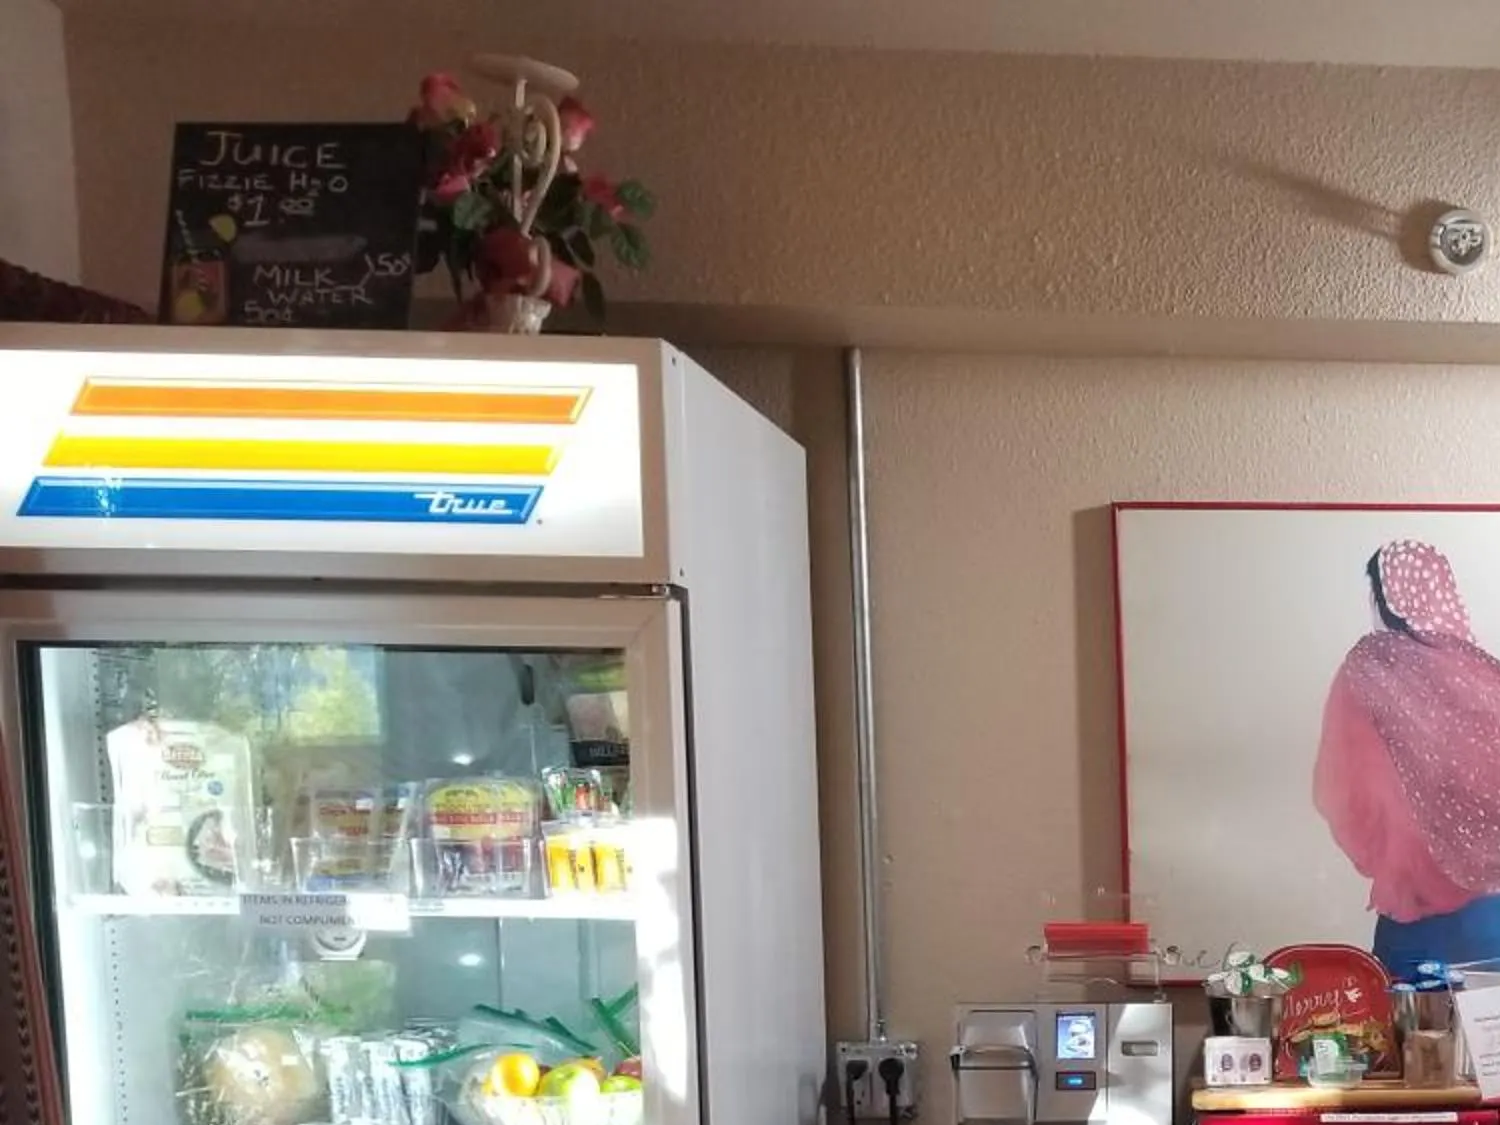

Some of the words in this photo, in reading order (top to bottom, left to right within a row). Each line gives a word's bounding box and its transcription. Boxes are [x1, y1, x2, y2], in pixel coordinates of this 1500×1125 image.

[200, 131, 346, 168] JUICE
[253, 264, 336, 288] MILK
[267, 286, 374, 307] WATER
